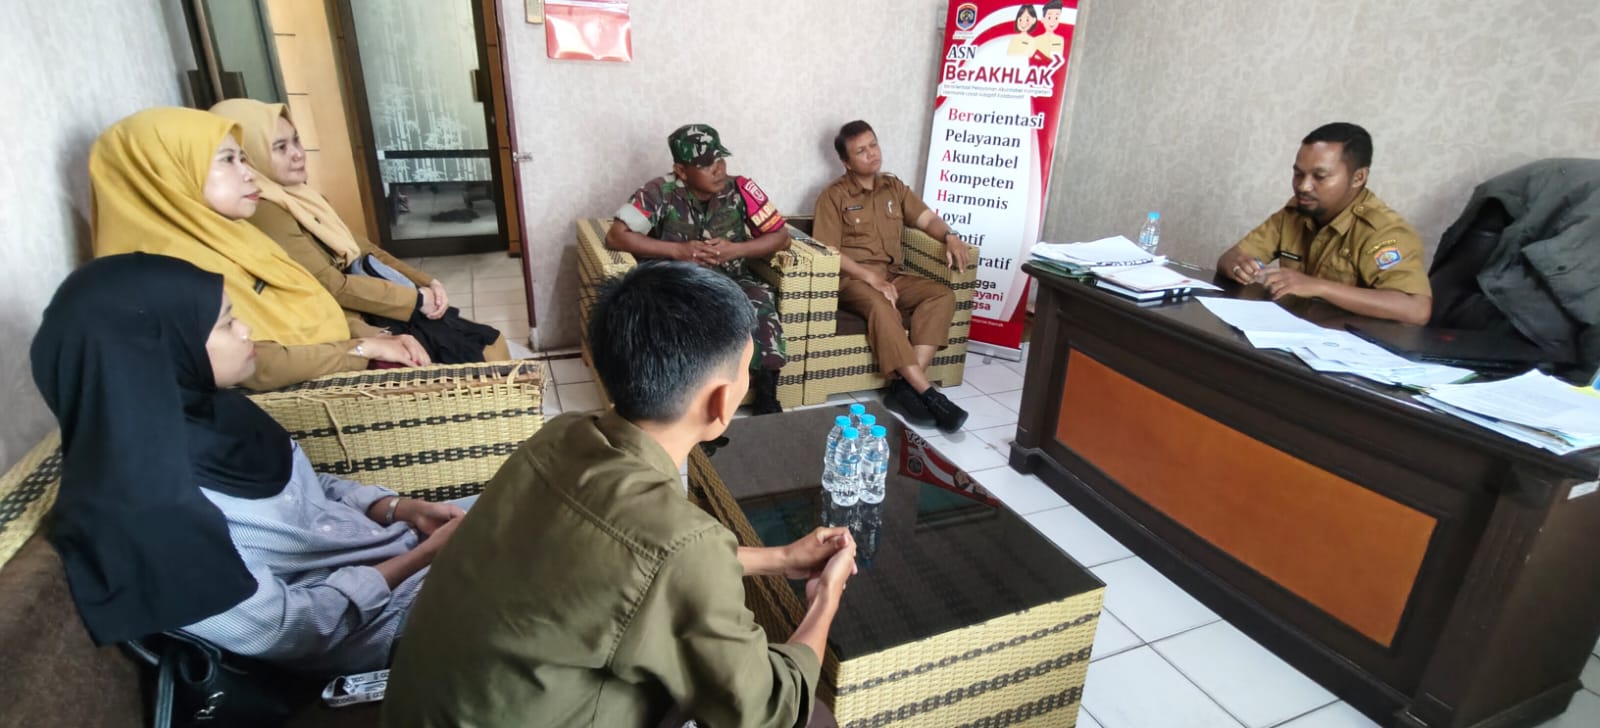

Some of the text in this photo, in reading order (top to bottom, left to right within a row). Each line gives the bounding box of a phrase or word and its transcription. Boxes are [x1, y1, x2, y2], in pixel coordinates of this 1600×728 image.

[948, 45, 976, 59] ASN
[945, 64, 1053, 86] BerAKHLAK
[948, 107, 1043, 128] Berorientasi
[945, 128, 1021, 148] Pelayanan
[941, 149, 1018, 169] Akuntabel
[939, 169, 1014, 190] Kompeten
[936, 189, 1009, 210] Harmonis
[959, 233, 986, 246] ptif
[978, 257, 1013, 270] ratif
[975, 279, 997, 290] gga
[972, 290, 1004, 302] ayani
[972, 301, 991, 311] gsa
